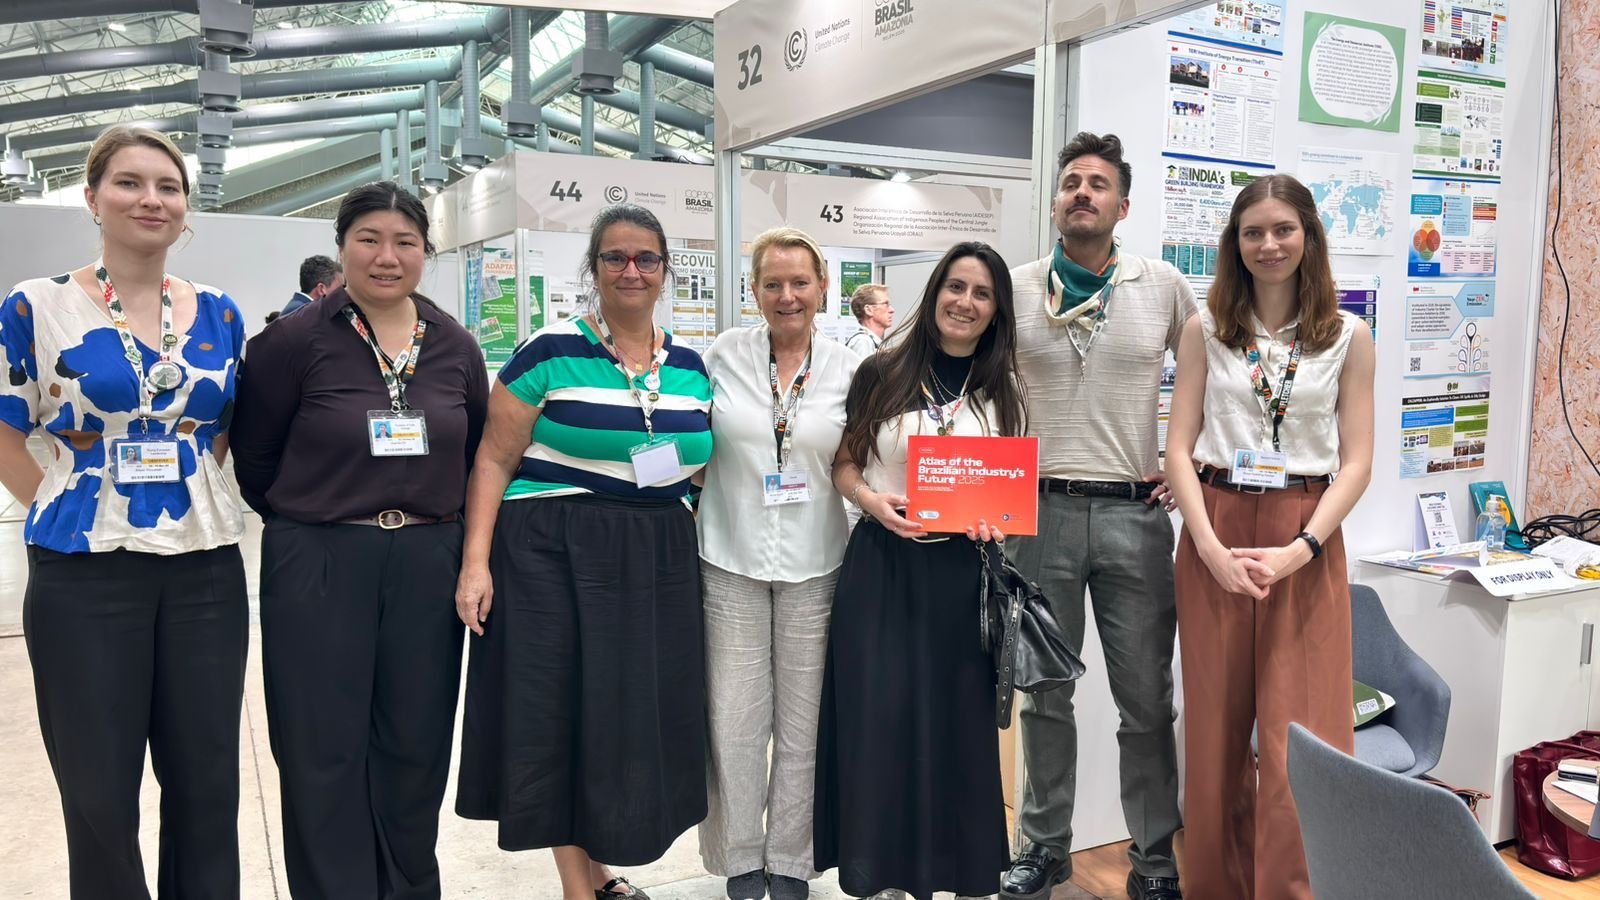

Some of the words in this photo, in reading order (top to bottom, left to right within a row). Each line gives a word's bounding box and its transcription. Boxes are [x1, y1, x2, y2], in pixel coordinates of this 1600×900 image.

[875, 0, 914, 25] BRASIL
[814, 24, 831, 39] United
[831, 17, 851, 31] Nations
[814, 39, 832, 53] Climate
[832, 32, 850, 46] Change
[737, 44, 763, 90] 32
[1189, 167, 1225, 184] INDIA's
[550, 180, 582, 202] 44
[1180, 180, 1199, 188] BUILDING
[1200, 182, 1225, 190] FRAMEWORK
[685, 189, 713, 200] COP30
[685, 198, 714, 208] BRASIL
[820, 204, 844, 223] 43
[672, 254, 715, 268] ECOVIL
[918, 456, 947, 466] Atlas
[949, 457, 961, 466] of
[964, 457, 983, 467] the
[918, 465, 966, 475] Brazilian
[968, 467, 1025, 479] Industry's
[918, 474, 956, 484] Future
[958, 476, 985, 485] 2025
[1490, 575, 1510, 585] FOR
[1506, 571, 1537, 583] DISPLAY
[1534, 569, 1555, 579] ONLY
